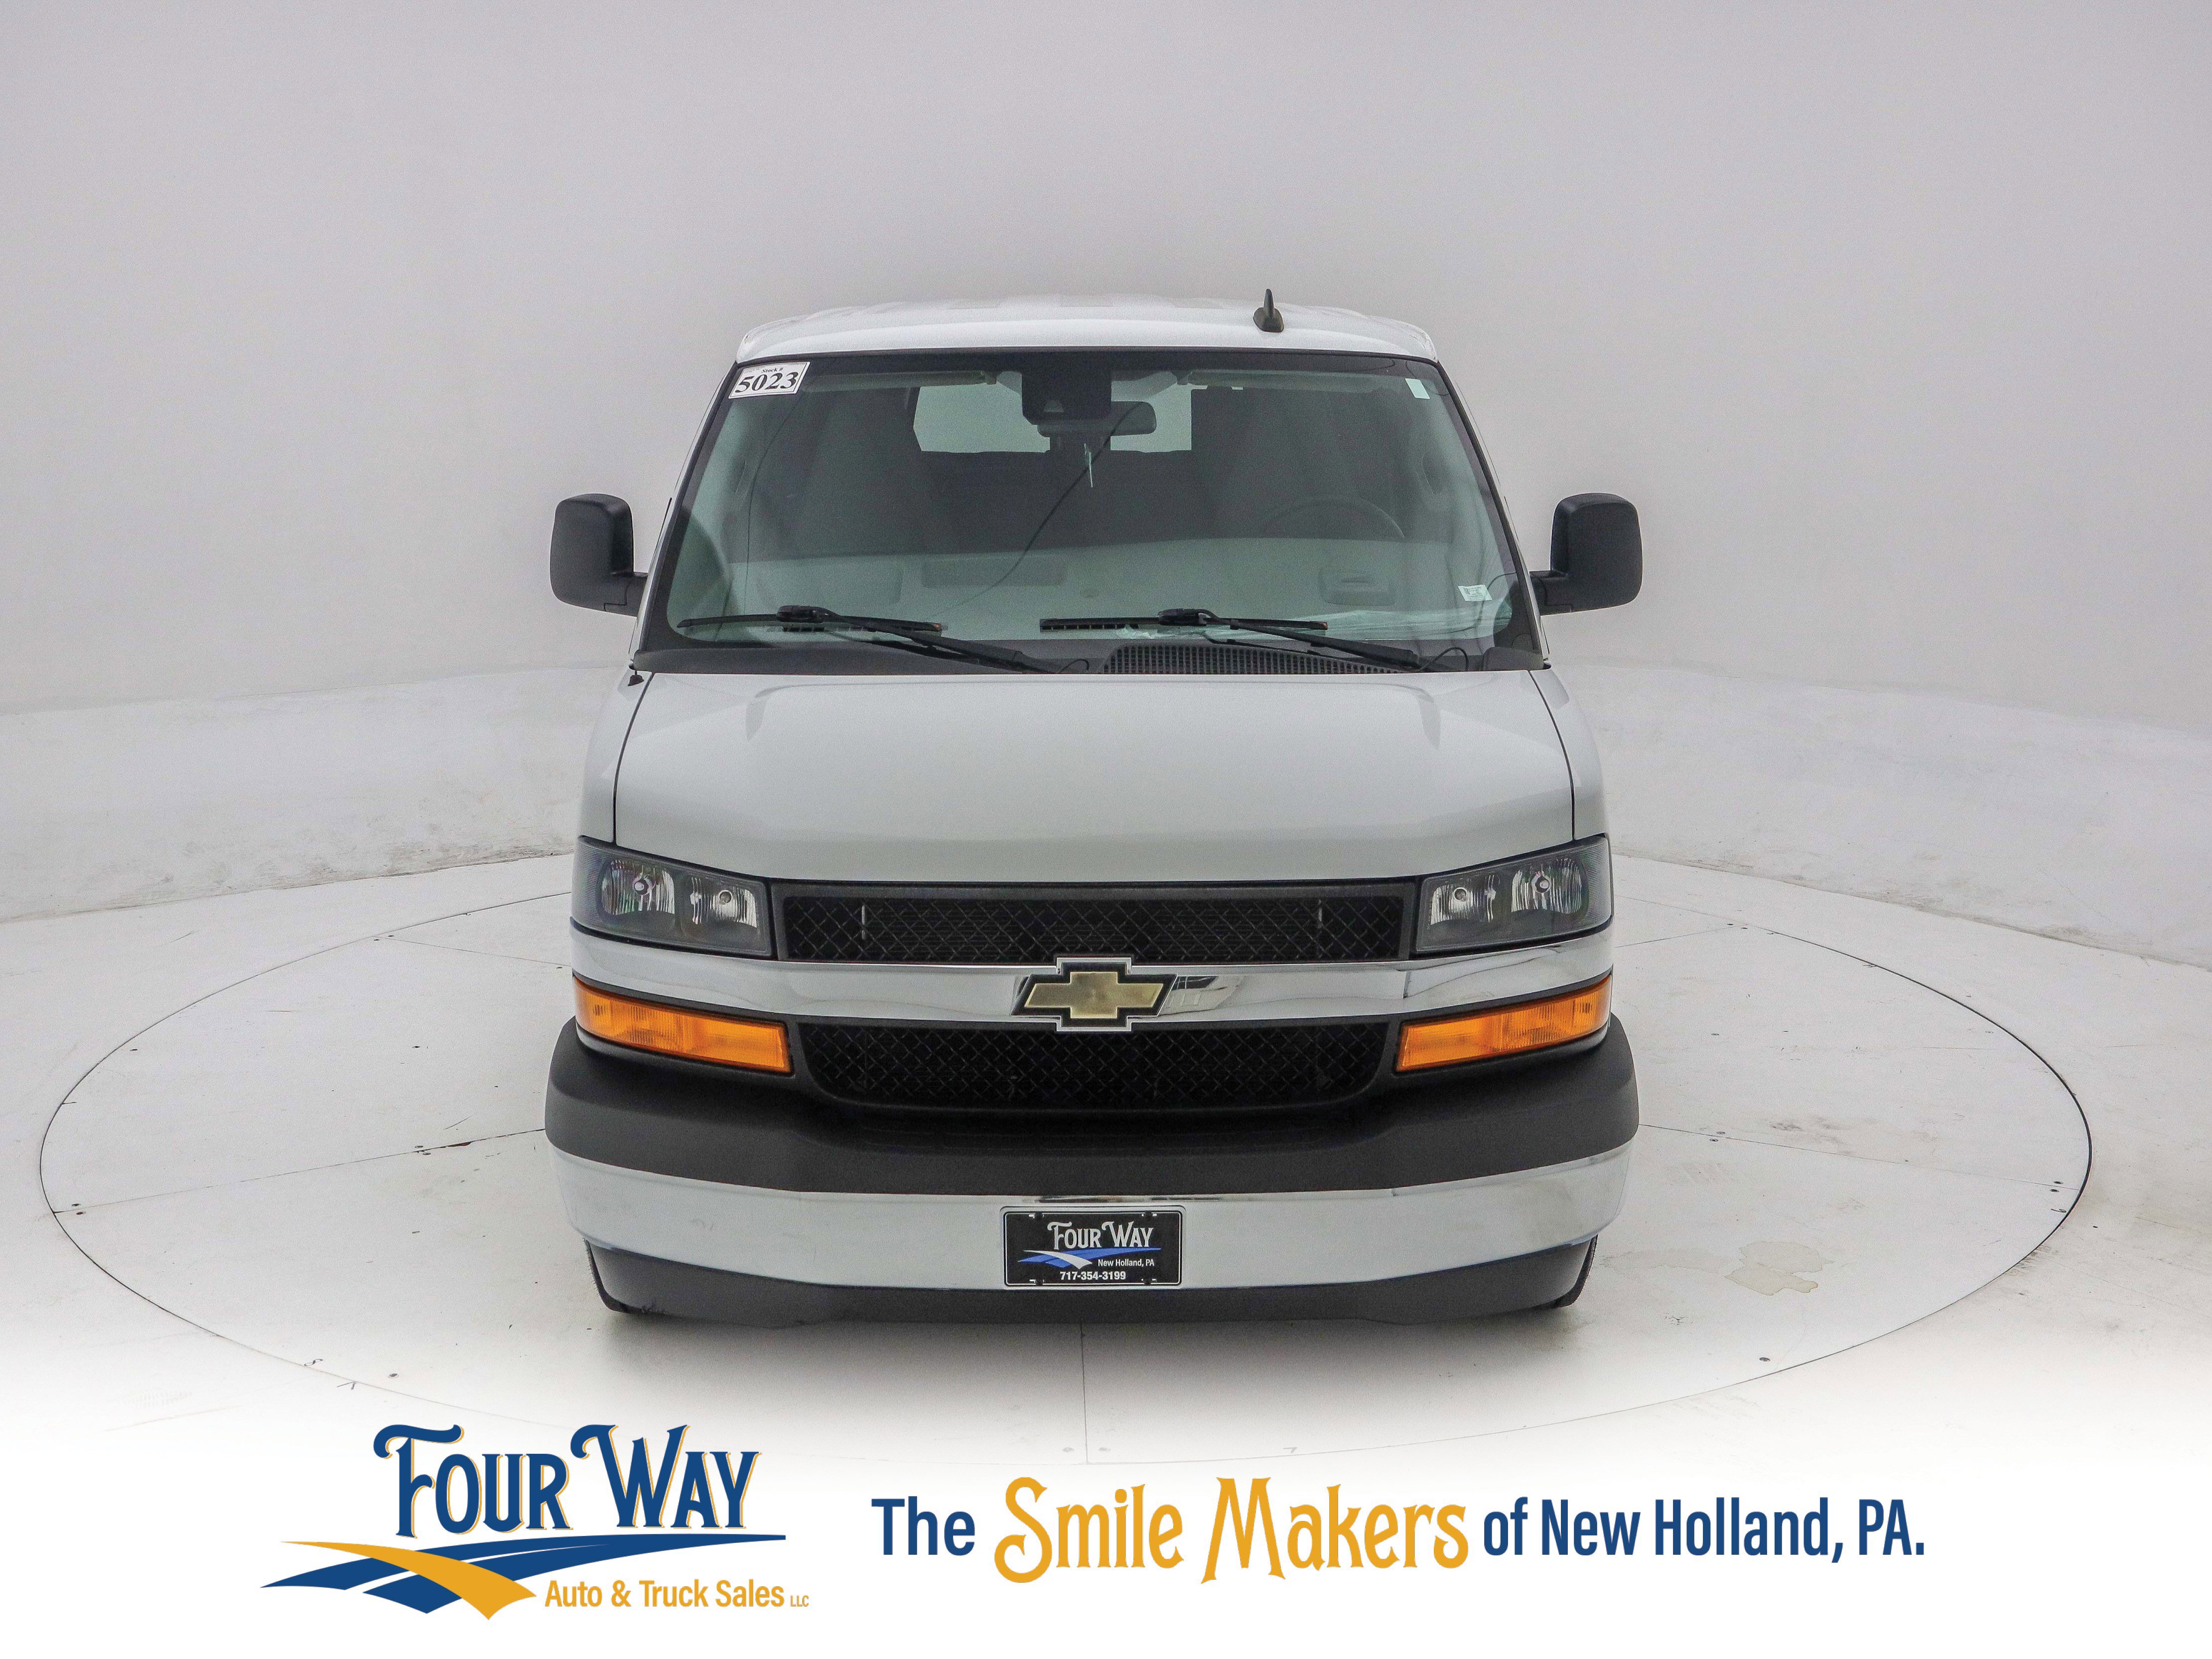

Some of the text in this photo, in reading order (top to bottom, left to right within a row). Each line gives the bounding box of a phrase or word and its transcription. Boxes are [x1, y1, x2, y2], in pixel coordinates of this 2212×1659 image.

[735, 372, 799, 393] 5023
[1115, 1258, 1144, 1267] Holland,
[1060, 1271, 1126, 1281] 717-354-3199
